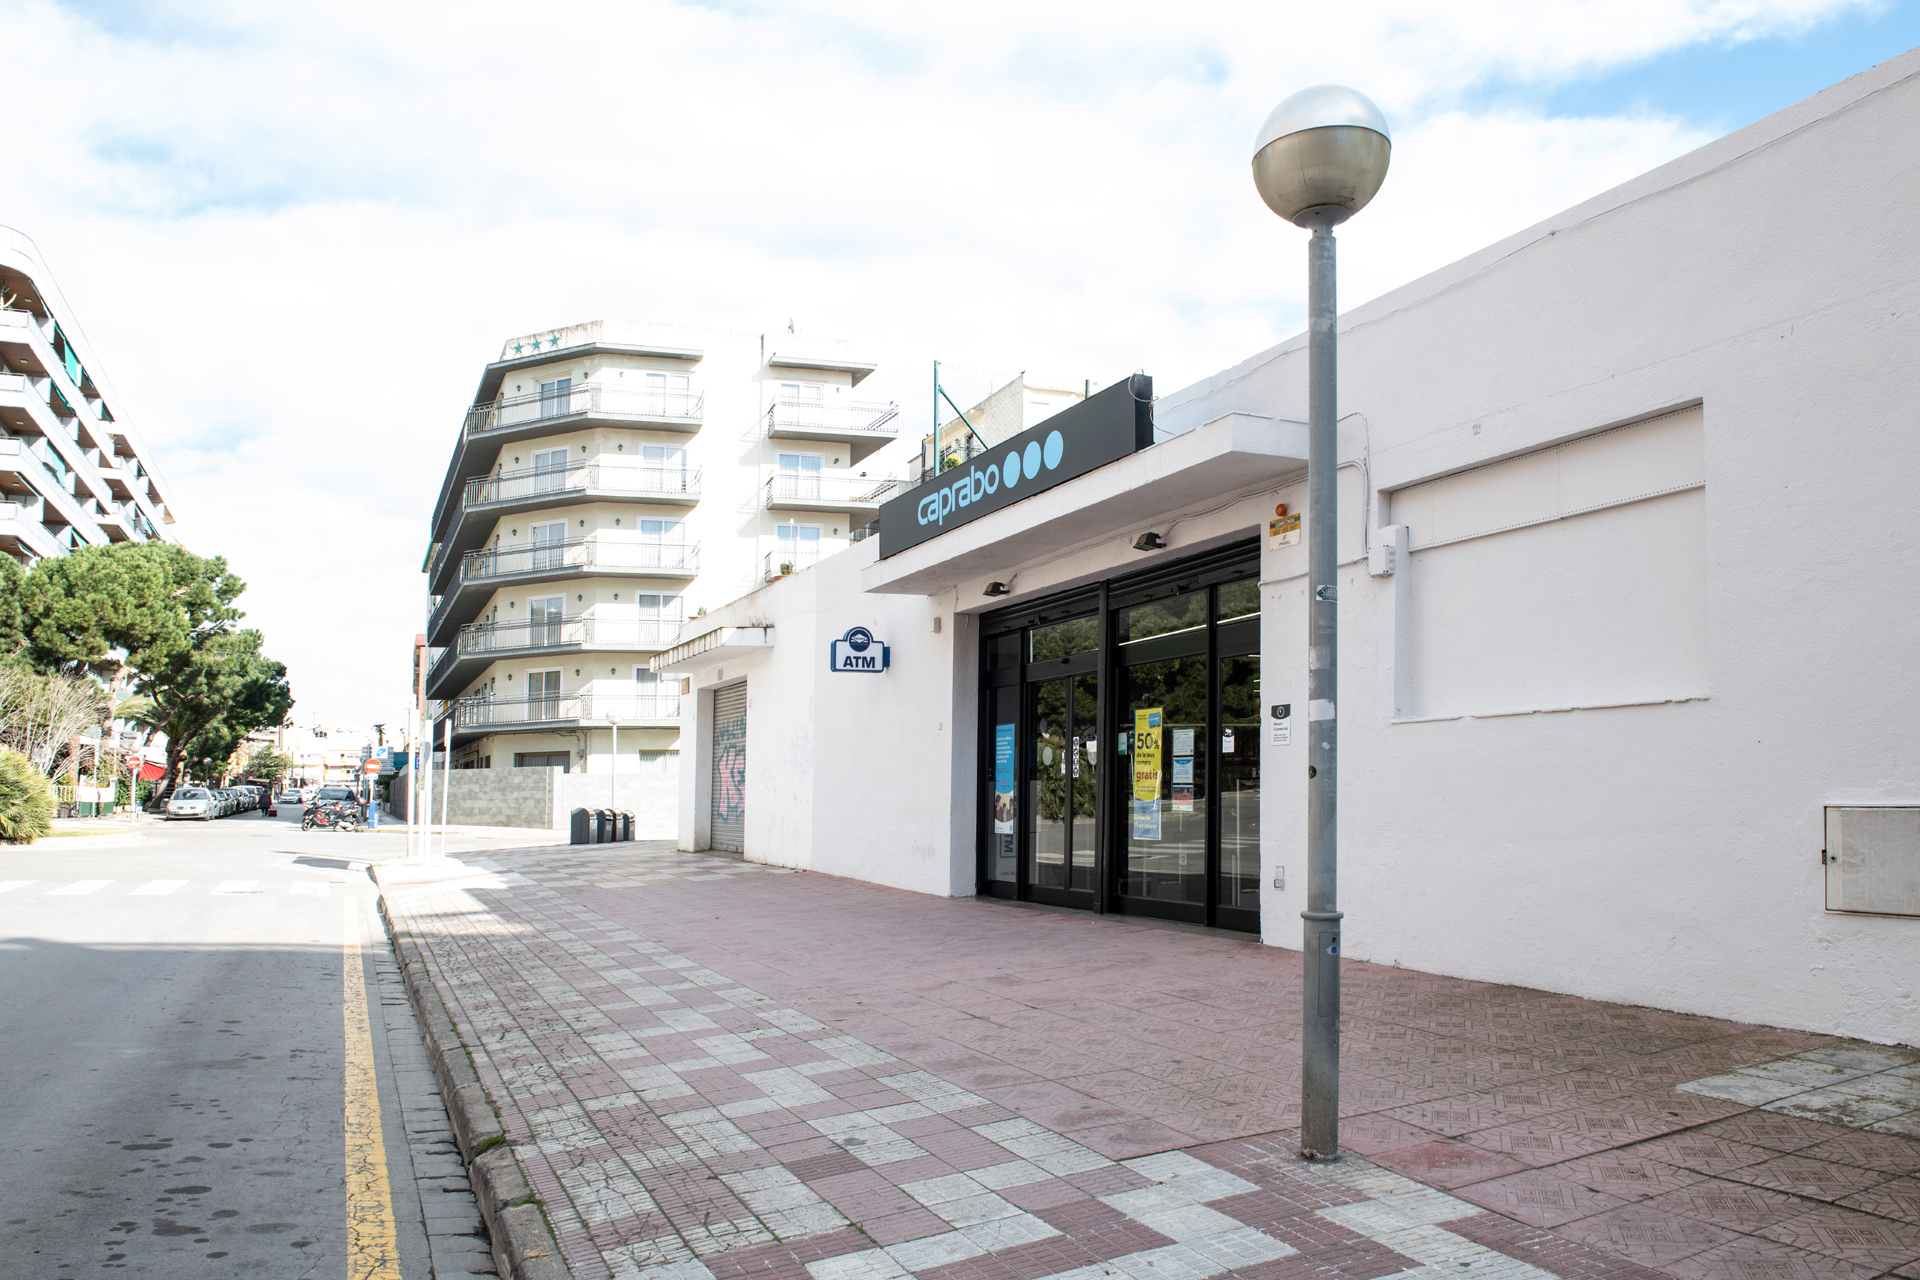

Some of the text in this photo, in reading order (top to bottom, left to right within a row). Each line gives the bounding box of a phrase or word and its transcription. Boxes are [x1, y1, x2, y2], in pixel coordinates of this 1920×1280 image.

[918, 464, 999, 526] caprabo
[843, 656, 876, 668] ATM
[1136, 732, 1160, 750] 50%
[1136, 769, 1159, 782] gratis
